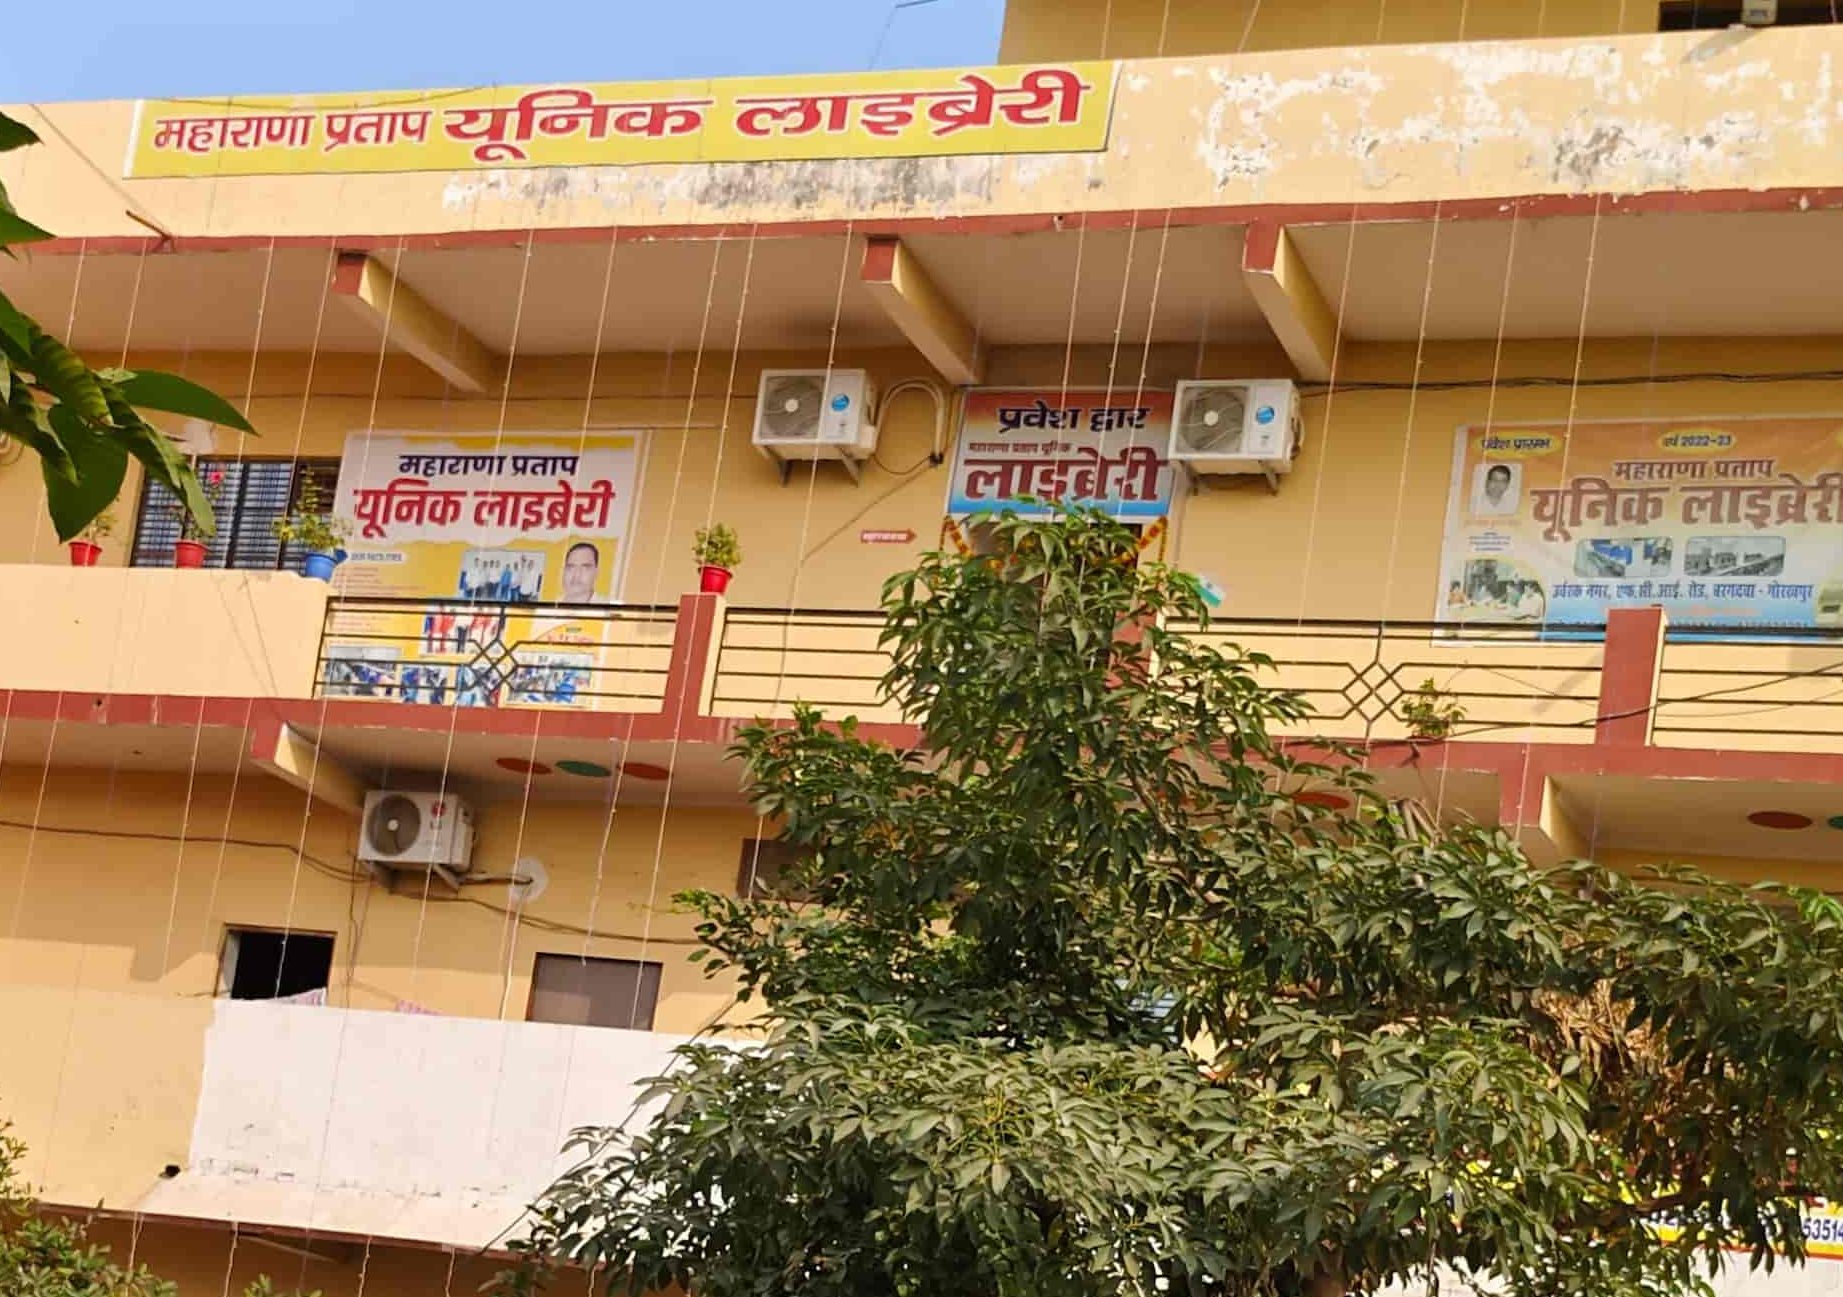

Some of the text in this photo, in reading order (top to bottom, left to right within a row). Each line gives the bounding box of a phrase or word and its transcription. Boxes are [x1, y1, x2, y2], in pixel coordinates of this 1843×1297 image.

[154, 69, 1091, 162] महाराणा प्रताप यूनिक लाइब्रेरी
[998, 400, 1150, 433] प्रवेश द्वार
[399, 453, 580, 477] महाराणा प्रताप
[964, 446, 1169, 503] लाइब्रेरी
[1612, 457, 1775, 482] महाराणा प्रताप
[353, 478, 616, 539] यूनिक लाइब्रेरी
[1530, 475, 1670, 542] यूनिक
